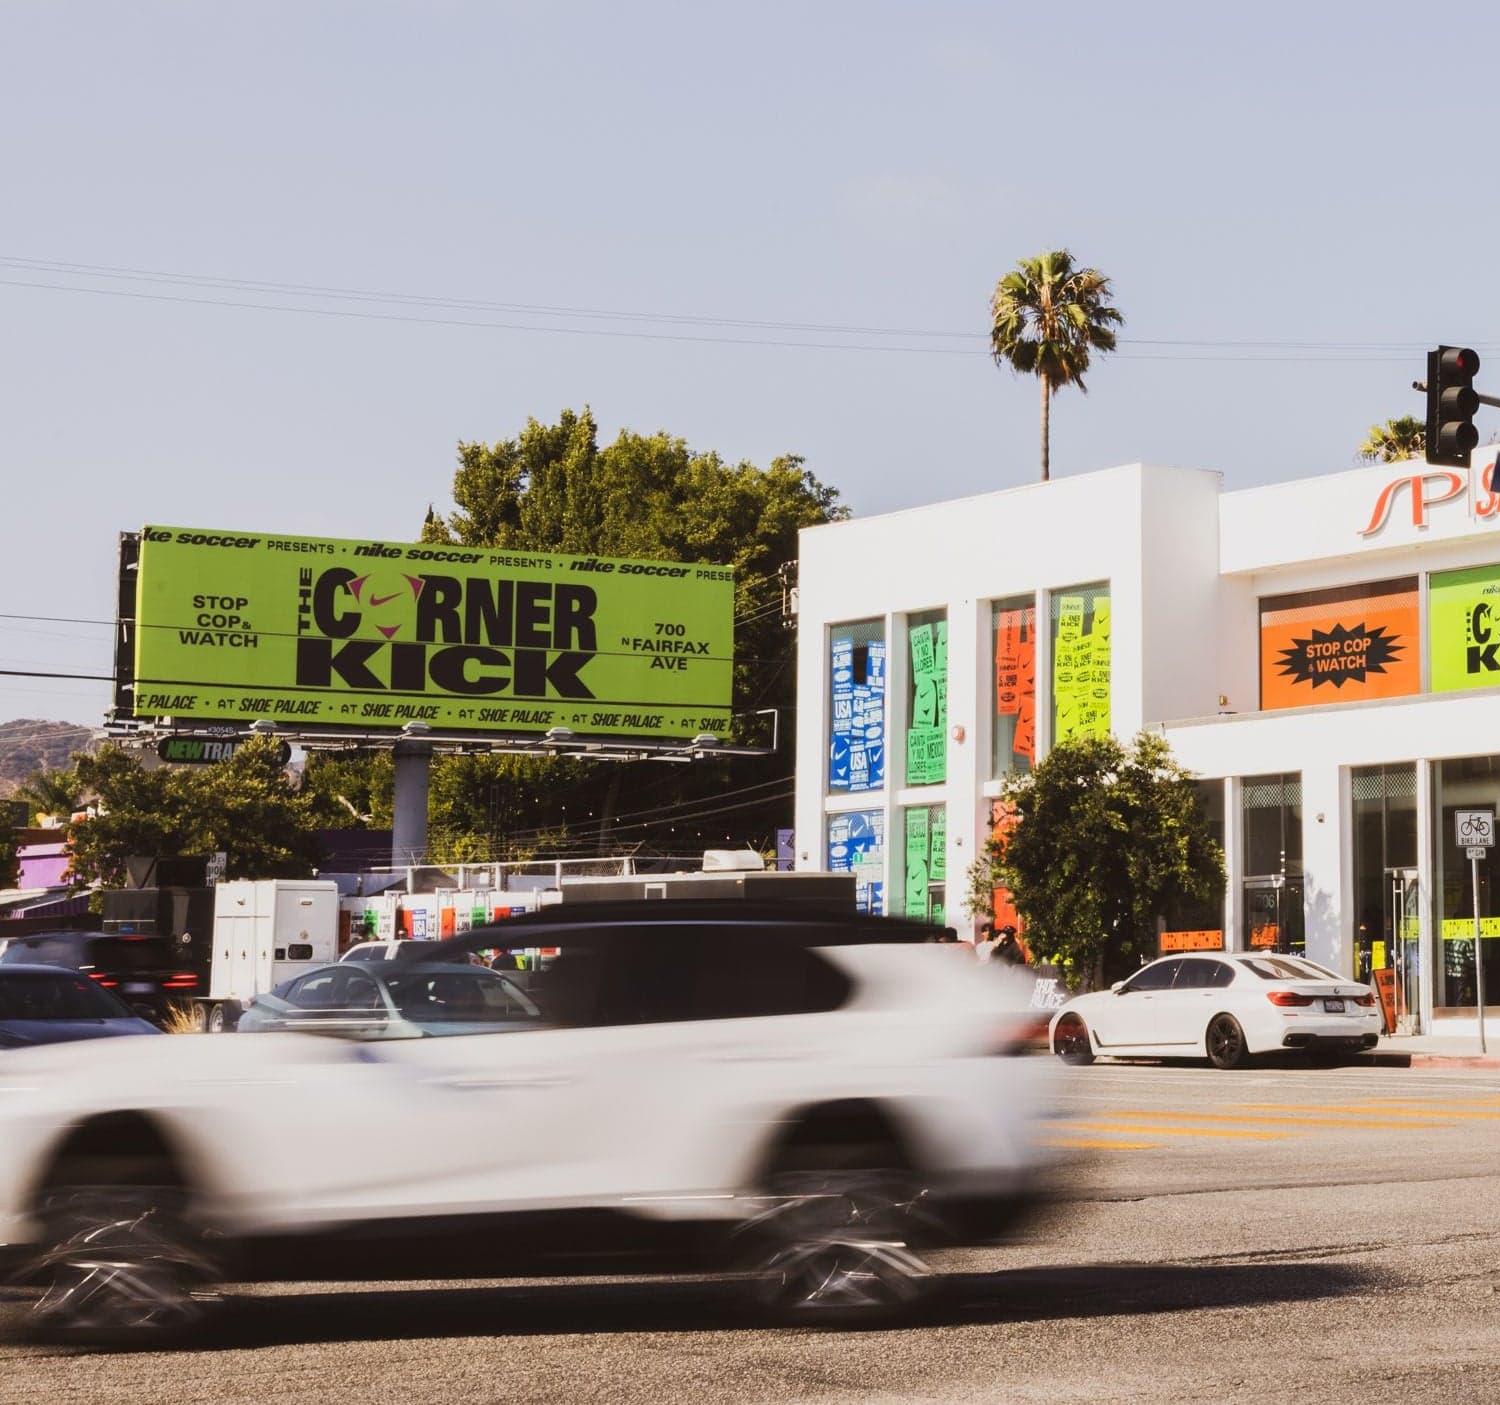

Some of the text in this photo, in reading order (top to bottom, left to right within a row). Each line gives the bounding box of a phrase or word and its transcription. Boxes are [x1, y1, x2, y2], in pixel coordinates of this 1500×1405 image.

[176, 531, 260, 548] soccer
[267, 540, 335, 555] PRESENTS
[353, 543, 402, 559] nike
[406, 549, 484, 565] soccer
[490, 556, 552, 569] PRESENTS
[570, 558, 615, 573] nike
[618, 563, 691, 578] soccer
[193, 595, 249, 611] STOP
[298, 567, 312, 636] THE
[313, 567, 598, 651] CRNER
[654, 623, 686, 636] 700
[179, 630, 258, 648] WATCH
[622, 637, 709, 655] N FAIRFAX
[1343, 637, 1372, 653] COP
[296, 637, 597, 700] KICK
[650, 656, 688, 670] AVE
[1316, 654, 1366, 673] WATCH
[147, 694, 198, 710] PALACE
[217, 699, 236, 710] AT
[238, 698, 273, 713] SHOE
[273, 699, 322, 715] PALACE
[341, 704, 358, 715] AT
[360, 704, 395, 719] SHOE
[394, 704, 441, 720] PALACE
[459, 708, 475, 720] AT
[478, 708, 511, 722] SHOE
[510, 709, 554, 725] PALACE
[572, 713, 588, 724] AT
[591, 713, 623, 727] SHOE
[622, 714, 665, 728] PALACE
[681, 718, 696, 728] AT
[699, 718, 729, 732] SHOE
[835, 700, 852, 718] USA
[850, 752, 867, 770] USA
